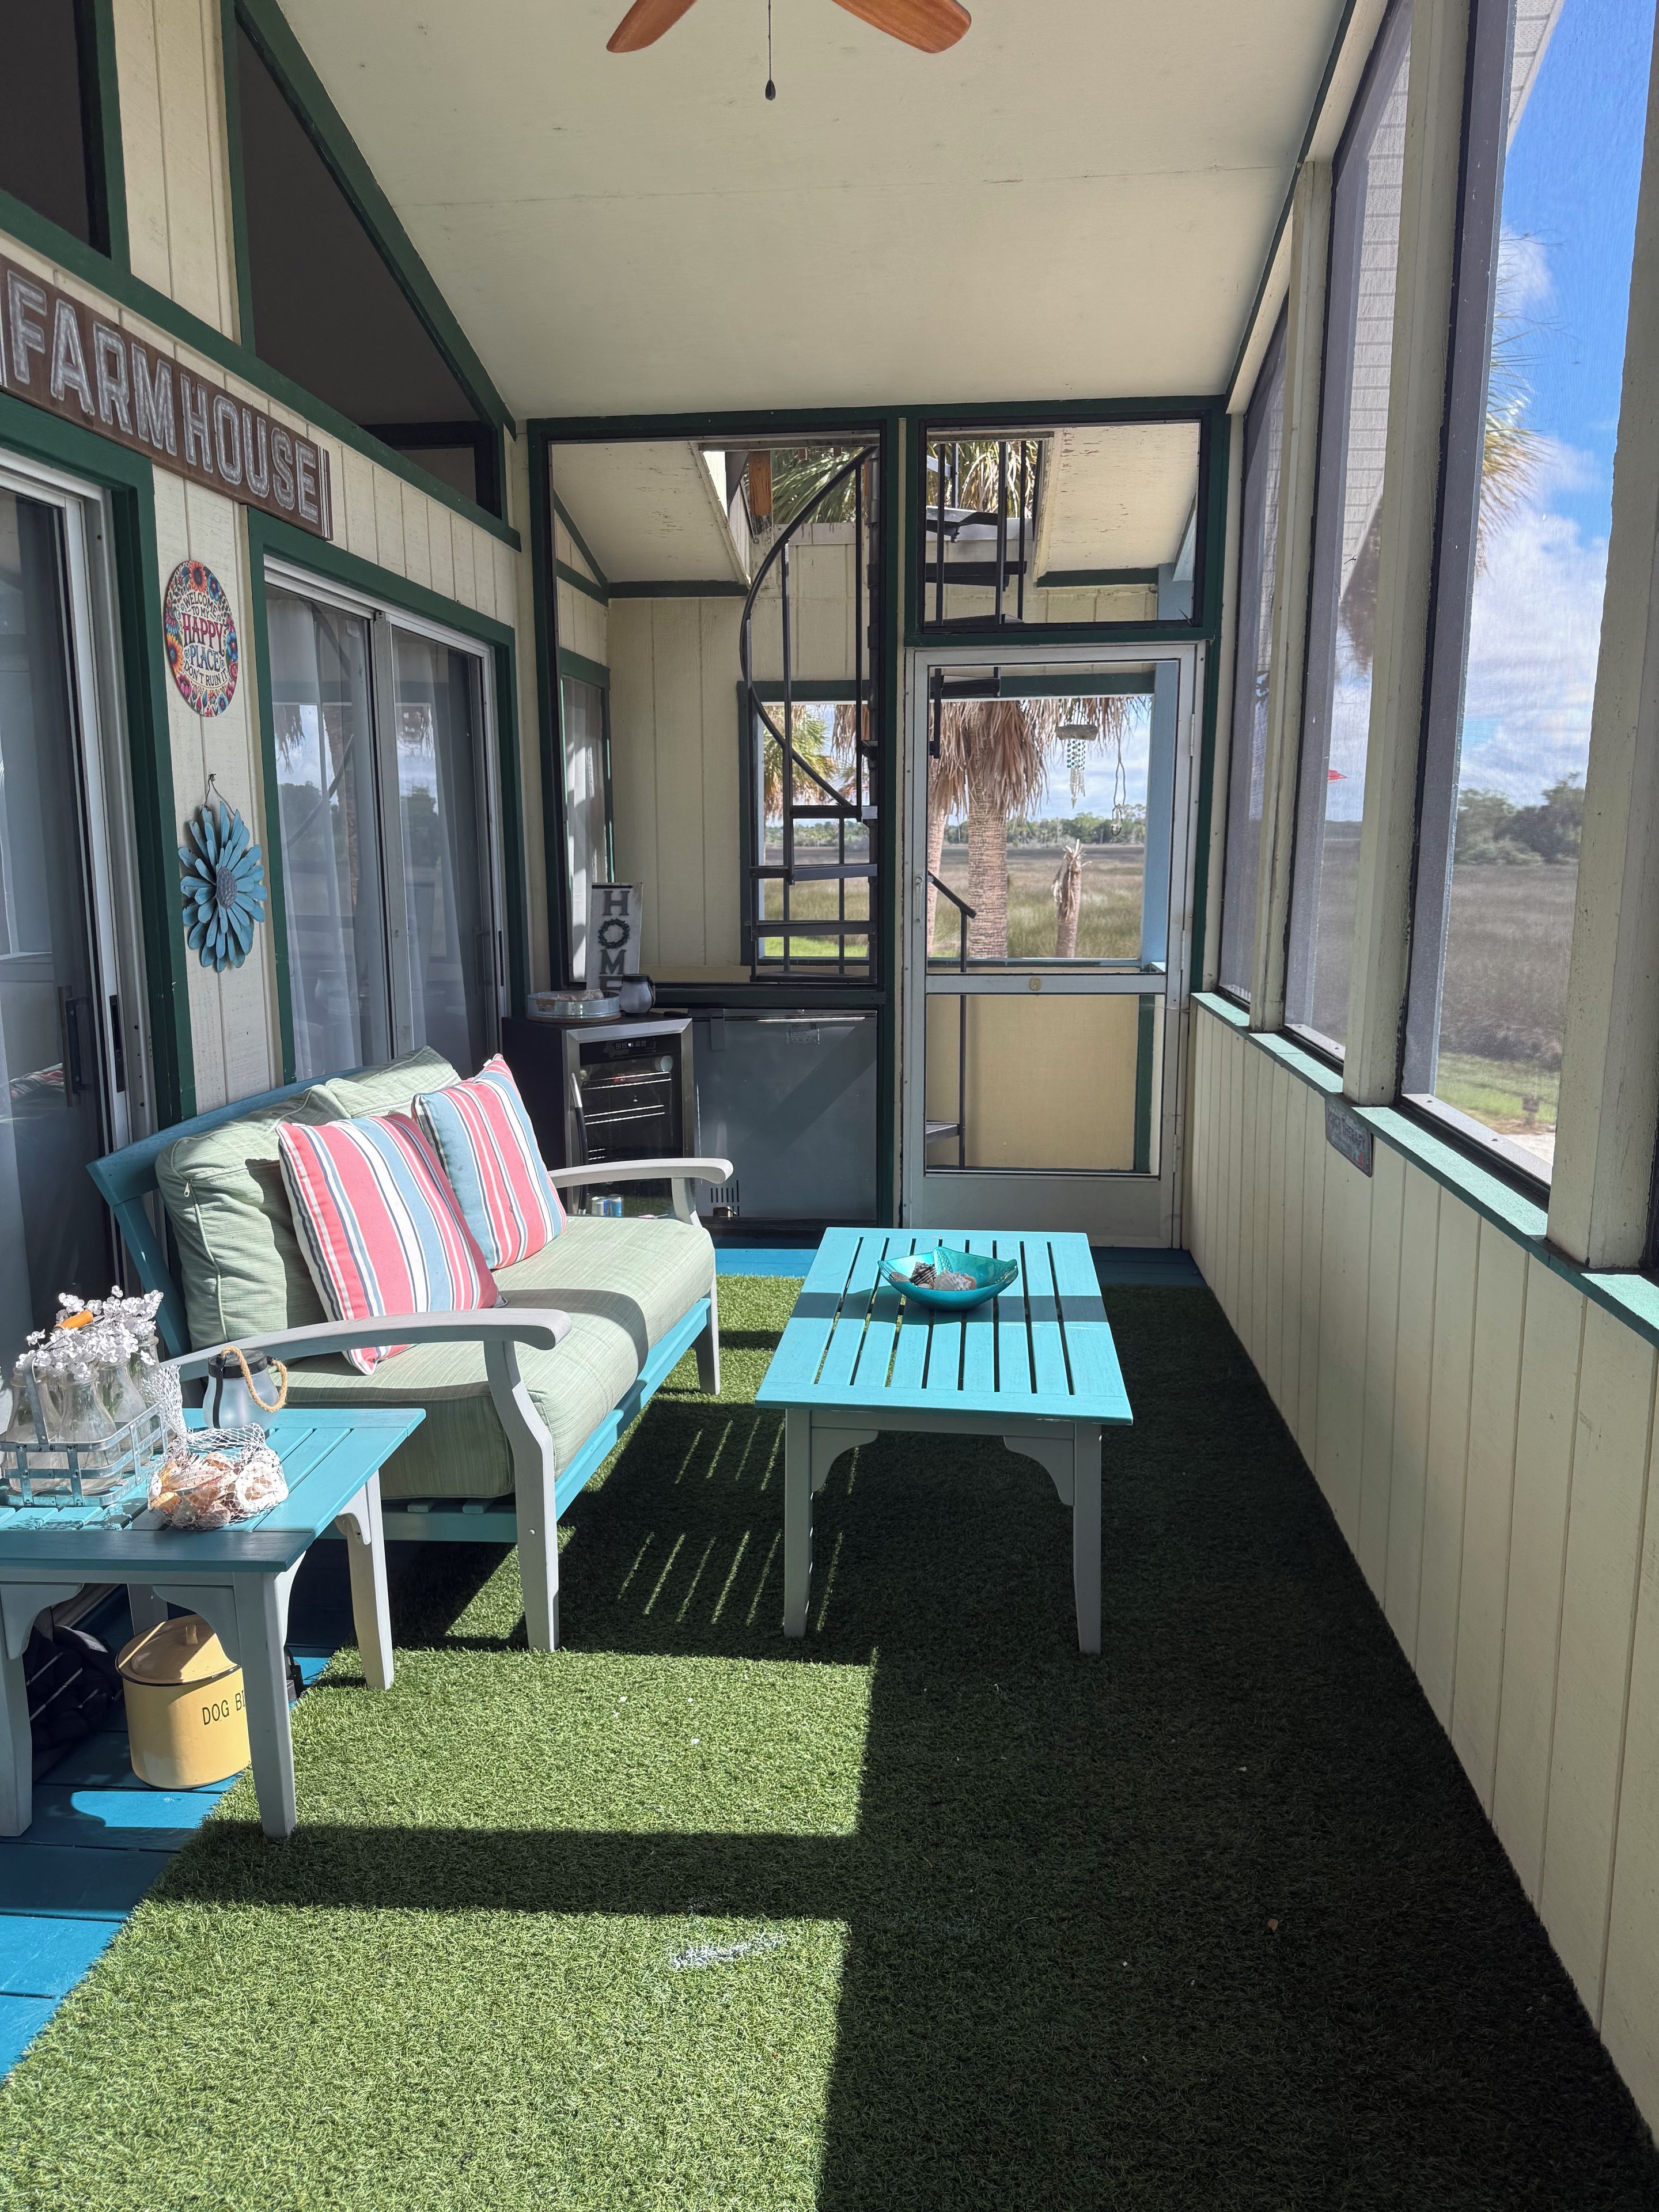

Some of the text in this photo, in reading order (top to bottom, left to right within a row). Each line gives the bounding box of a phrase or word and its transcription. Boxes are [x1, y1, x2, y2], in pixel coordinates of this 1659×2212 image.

[7, 269, 319, 524] FARMHOUSE
[183, 592, 218, 618] WELCOME
[191, 605, 209, 619] TO MY
[181, 612, 225, 657] HAPPY
[190, 645, 220, 672] PLACE
[184, 660, 228, 687] DON'T RUIN IT
[202, 1690, 245, 1726] DOG BI
